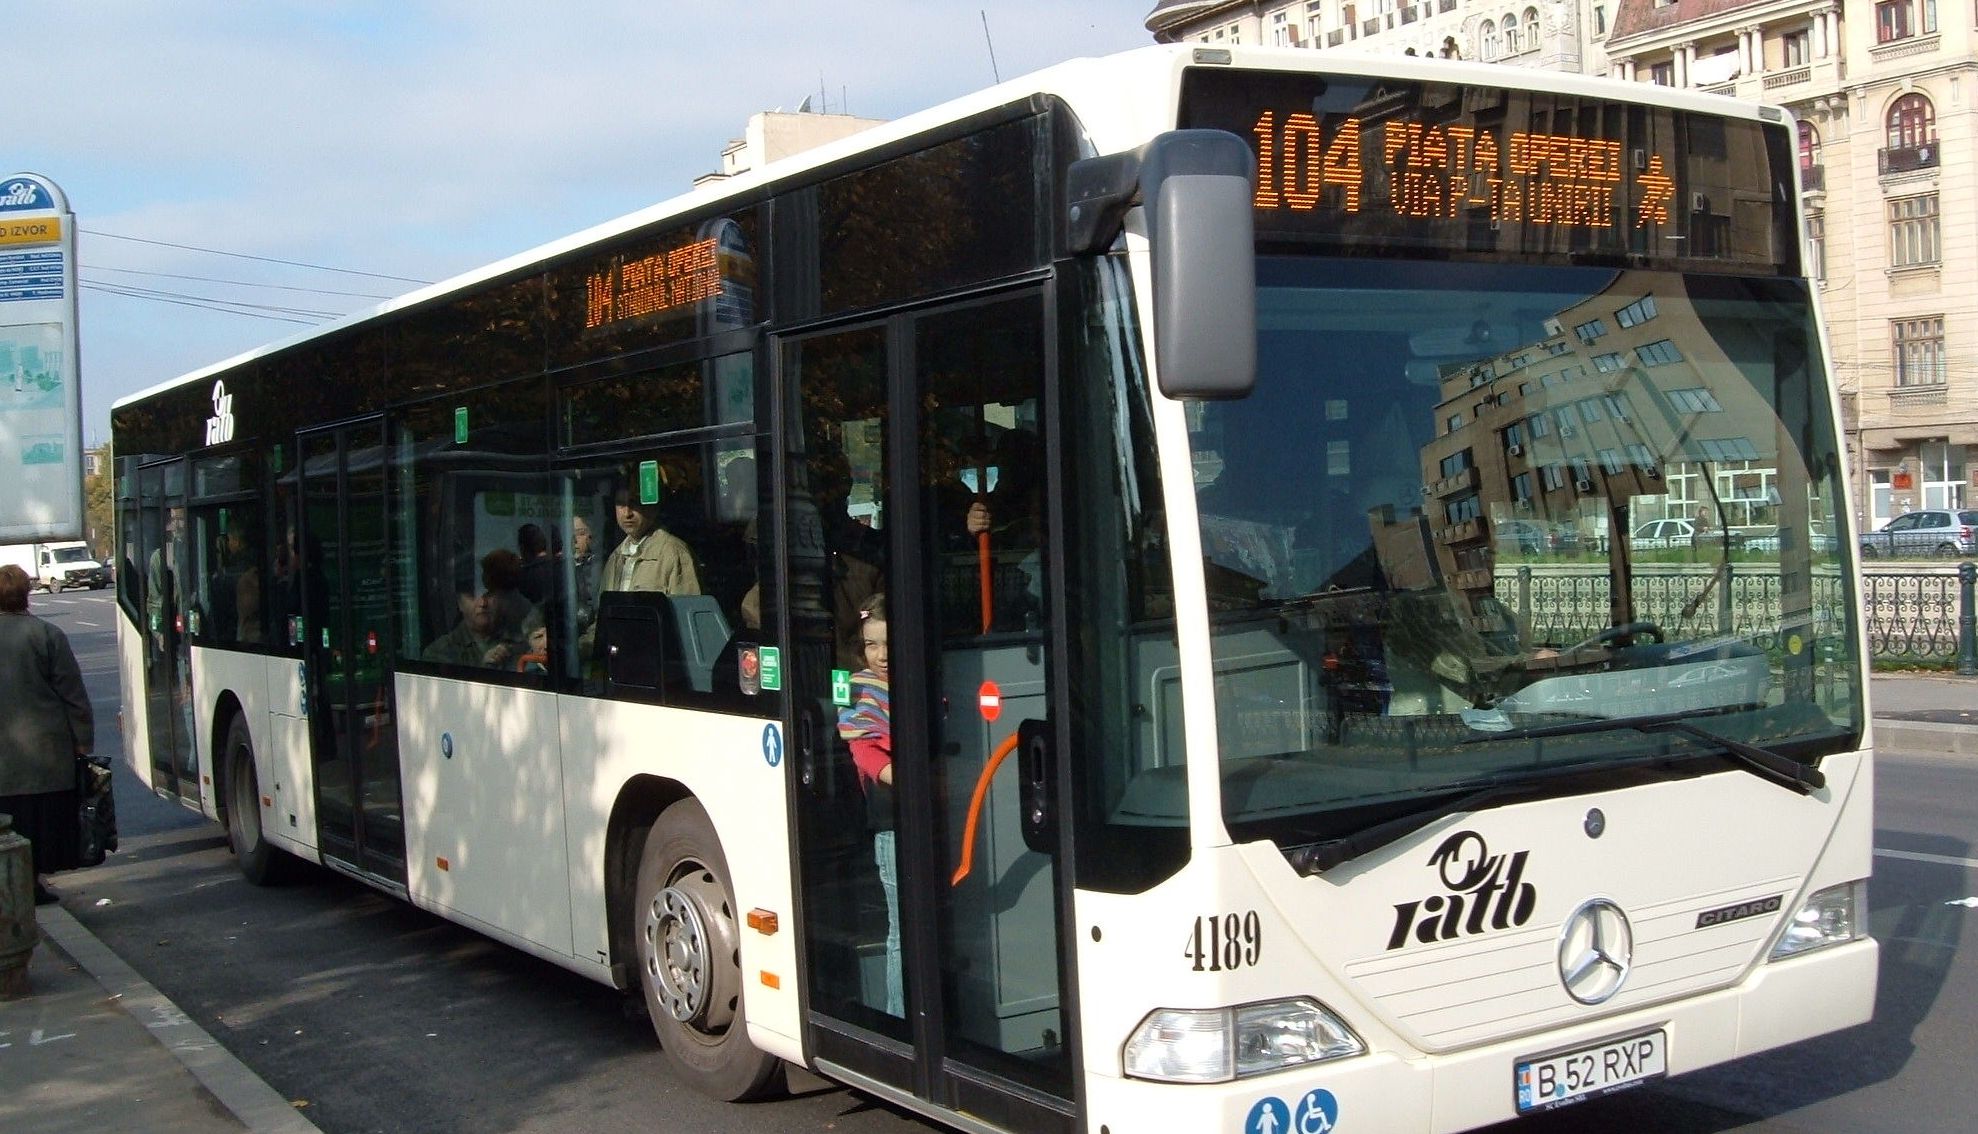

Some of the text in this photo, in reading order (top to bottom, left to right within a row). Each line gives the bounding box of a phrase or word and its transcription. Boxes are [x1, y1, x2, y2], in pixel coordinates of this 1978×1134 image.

[1254, 111, 1361, 212] 104
[1385, 121, 1621, 181] PIATA OPEREI
[1391, 171, 1612, 226] VIA P-TA UNIRII
[11, 224, 48, 237] IZVOR
[586, 270, 612, 328] 104
[622, 255, 664, 290] PIATA
[1184, 910, 1261, 971] 4189
[1699, 898, 1780, 925] CITARO
[1538, 1064, 1556, 1098] B
[1566, 1055, 1595, 1091] 52
[1603, 1040, 1654, 1082] RXP
